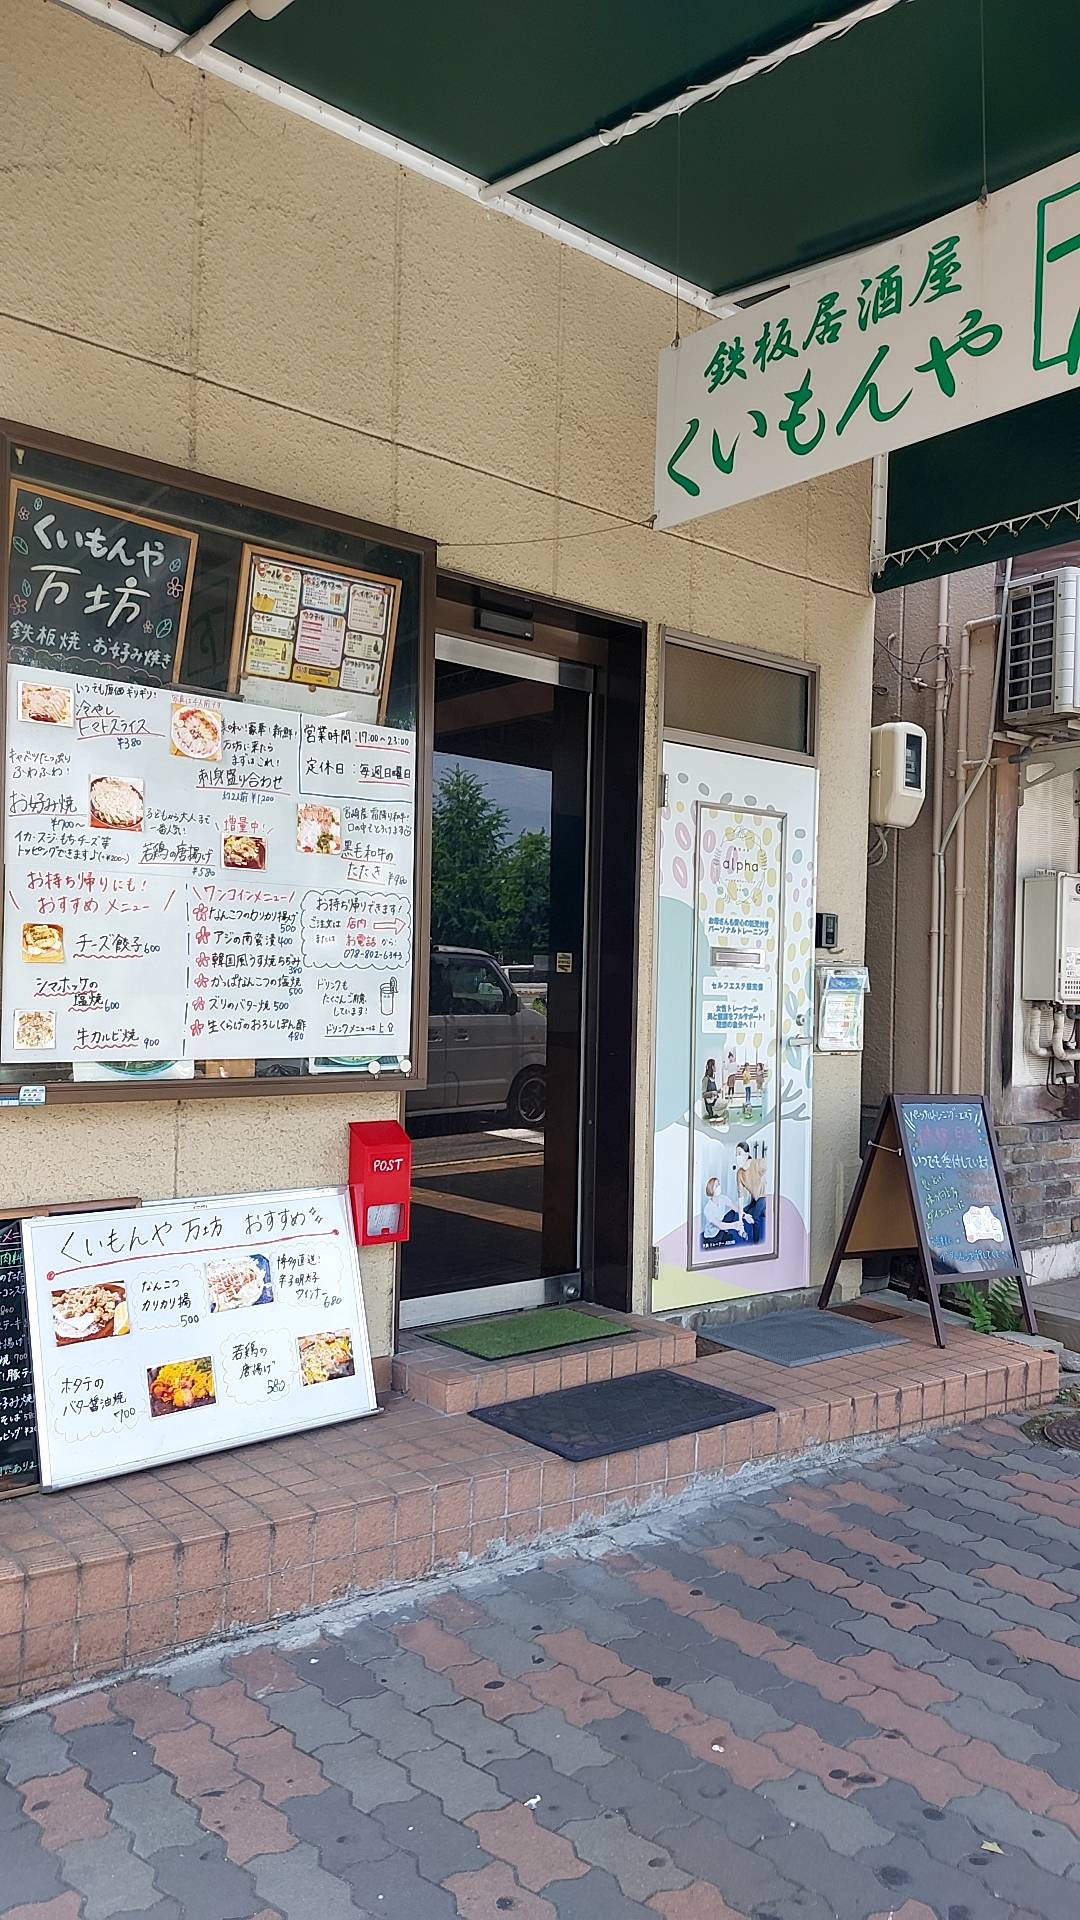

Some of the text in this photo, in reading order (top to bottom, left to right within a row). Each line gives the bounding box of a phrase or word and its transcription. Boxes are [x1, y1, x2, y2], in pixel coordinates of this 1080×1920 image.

[704, 236, 963, 393] 鉄板居酒屋
[667, 309, 1003, 496] くいもんや
[33, 514, 165, 577] くいもんや
[31, 565, 150, 627] 万坊
[75, 700, 115, 716] 冷やし
[78, 719, 150, 736] トマトスライス
[305, 757, 344, 775] 定休日
[198, 768, 283, 790] 刺身盛り合わせ
[10, 790, 77, 814] お好み焼
[141, 840, 214, 864] 若鶏の唐揚げ
[341, 840, 393, 862] 黒毛和牛の
[348, 862, 381, 880] たたき
[722, 857, 759, 874] alpha
[27, 872, 147, 892] お持ち帰りにも!
[280, 924, 296, 933] 500
[76, 933, 160, 954] チーズ餃子 600
[277, 936, 293, 948] 400
[35, 976, 98, 993] シマホッケの
[105, 1000, 120, 1012] 600
[273, 1001, 289, 1012] 500
[77, 1028, 159, 1050] 牛カルビ焼 900
[288, 1032, 304, 1041] 480
[373, 1159, 403, 1172] POST
[61, 1209, 306, 1263] くいもんや 万坊 おすすめ
[142, 1279, 180, 1293] なんこつ
[141, 1292, 191, 1312] カリカリ揚
[324, 1295, 342, 1308] 680
[181, 1314, 199, 1328] 500
[232, 1341, 268, 1360] 若鶏の
[61, 1376, 104, 1395] ホタテの
[267, 1378, 286, 1394] 580
